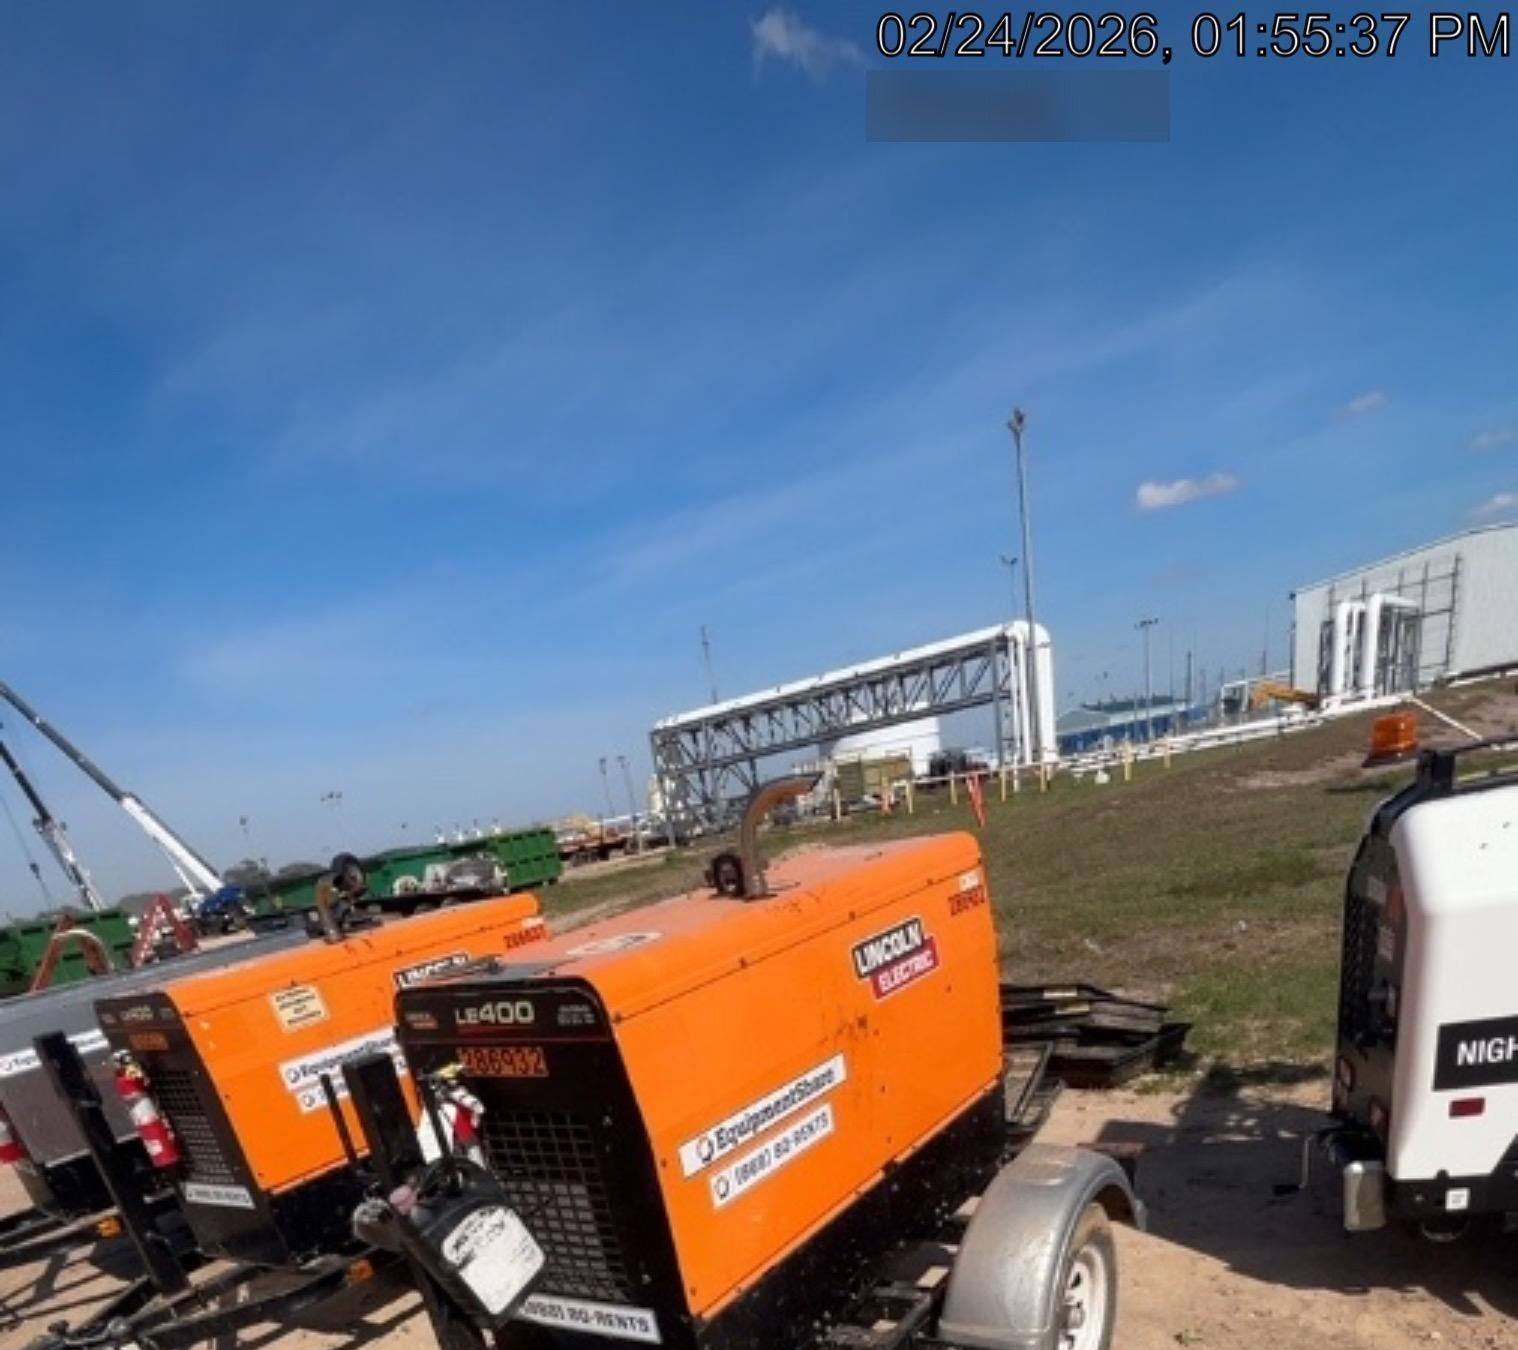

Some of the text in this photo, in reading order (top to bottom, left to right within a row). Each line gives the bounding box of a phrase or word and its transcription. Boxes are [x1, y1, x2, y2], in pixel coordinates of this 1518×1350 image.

[855, 922, 921, 974] LINCOLN
[878, 948, 935, 992] ELECTRIC
[455, 1001, 535, 1025] LE400
[715, 1068, 835, 1150] EquipmentShare
